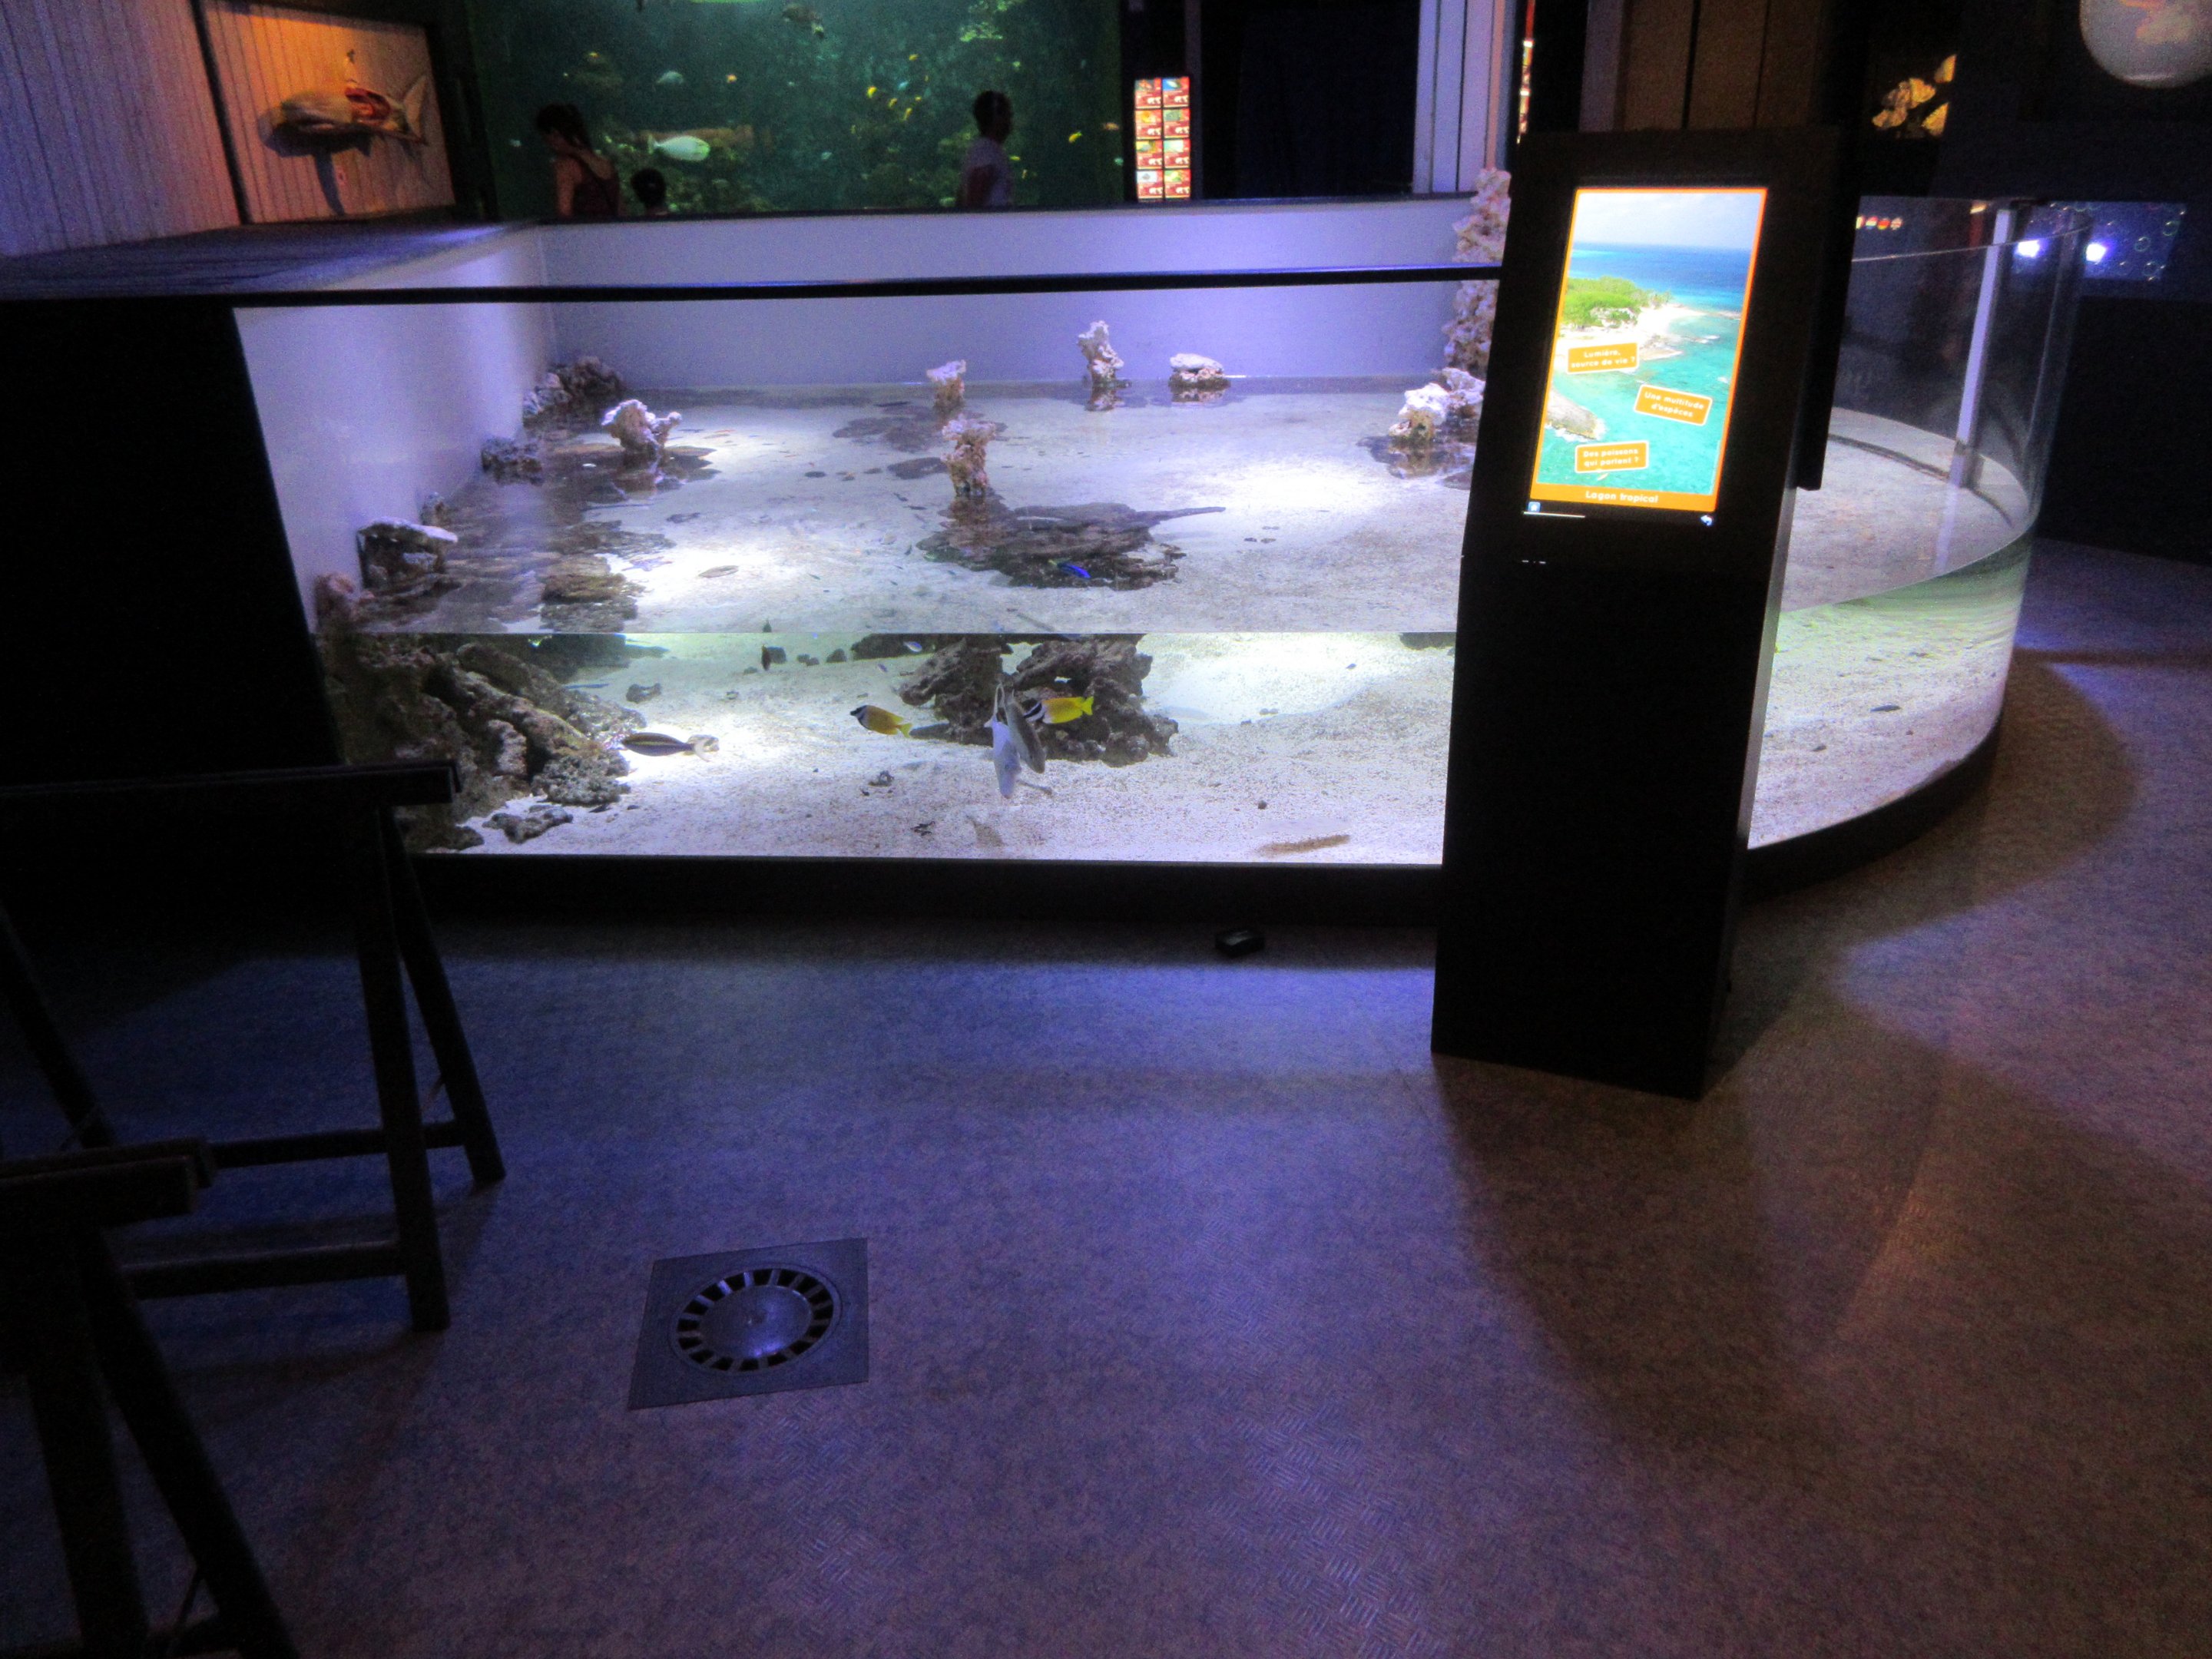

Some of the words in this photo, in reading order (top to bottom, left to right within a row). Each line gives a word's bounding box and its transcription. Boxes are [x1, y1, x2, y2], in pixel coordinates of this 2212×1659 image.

[1644, 392, 1661, 401] Une
[1664, 396, 1704, 409] multitude
[1601, 449, 1638, 457] poissons
[1585, 490, 1617, 501] Lagon
[1619, 493, 1659, 504] tropical
